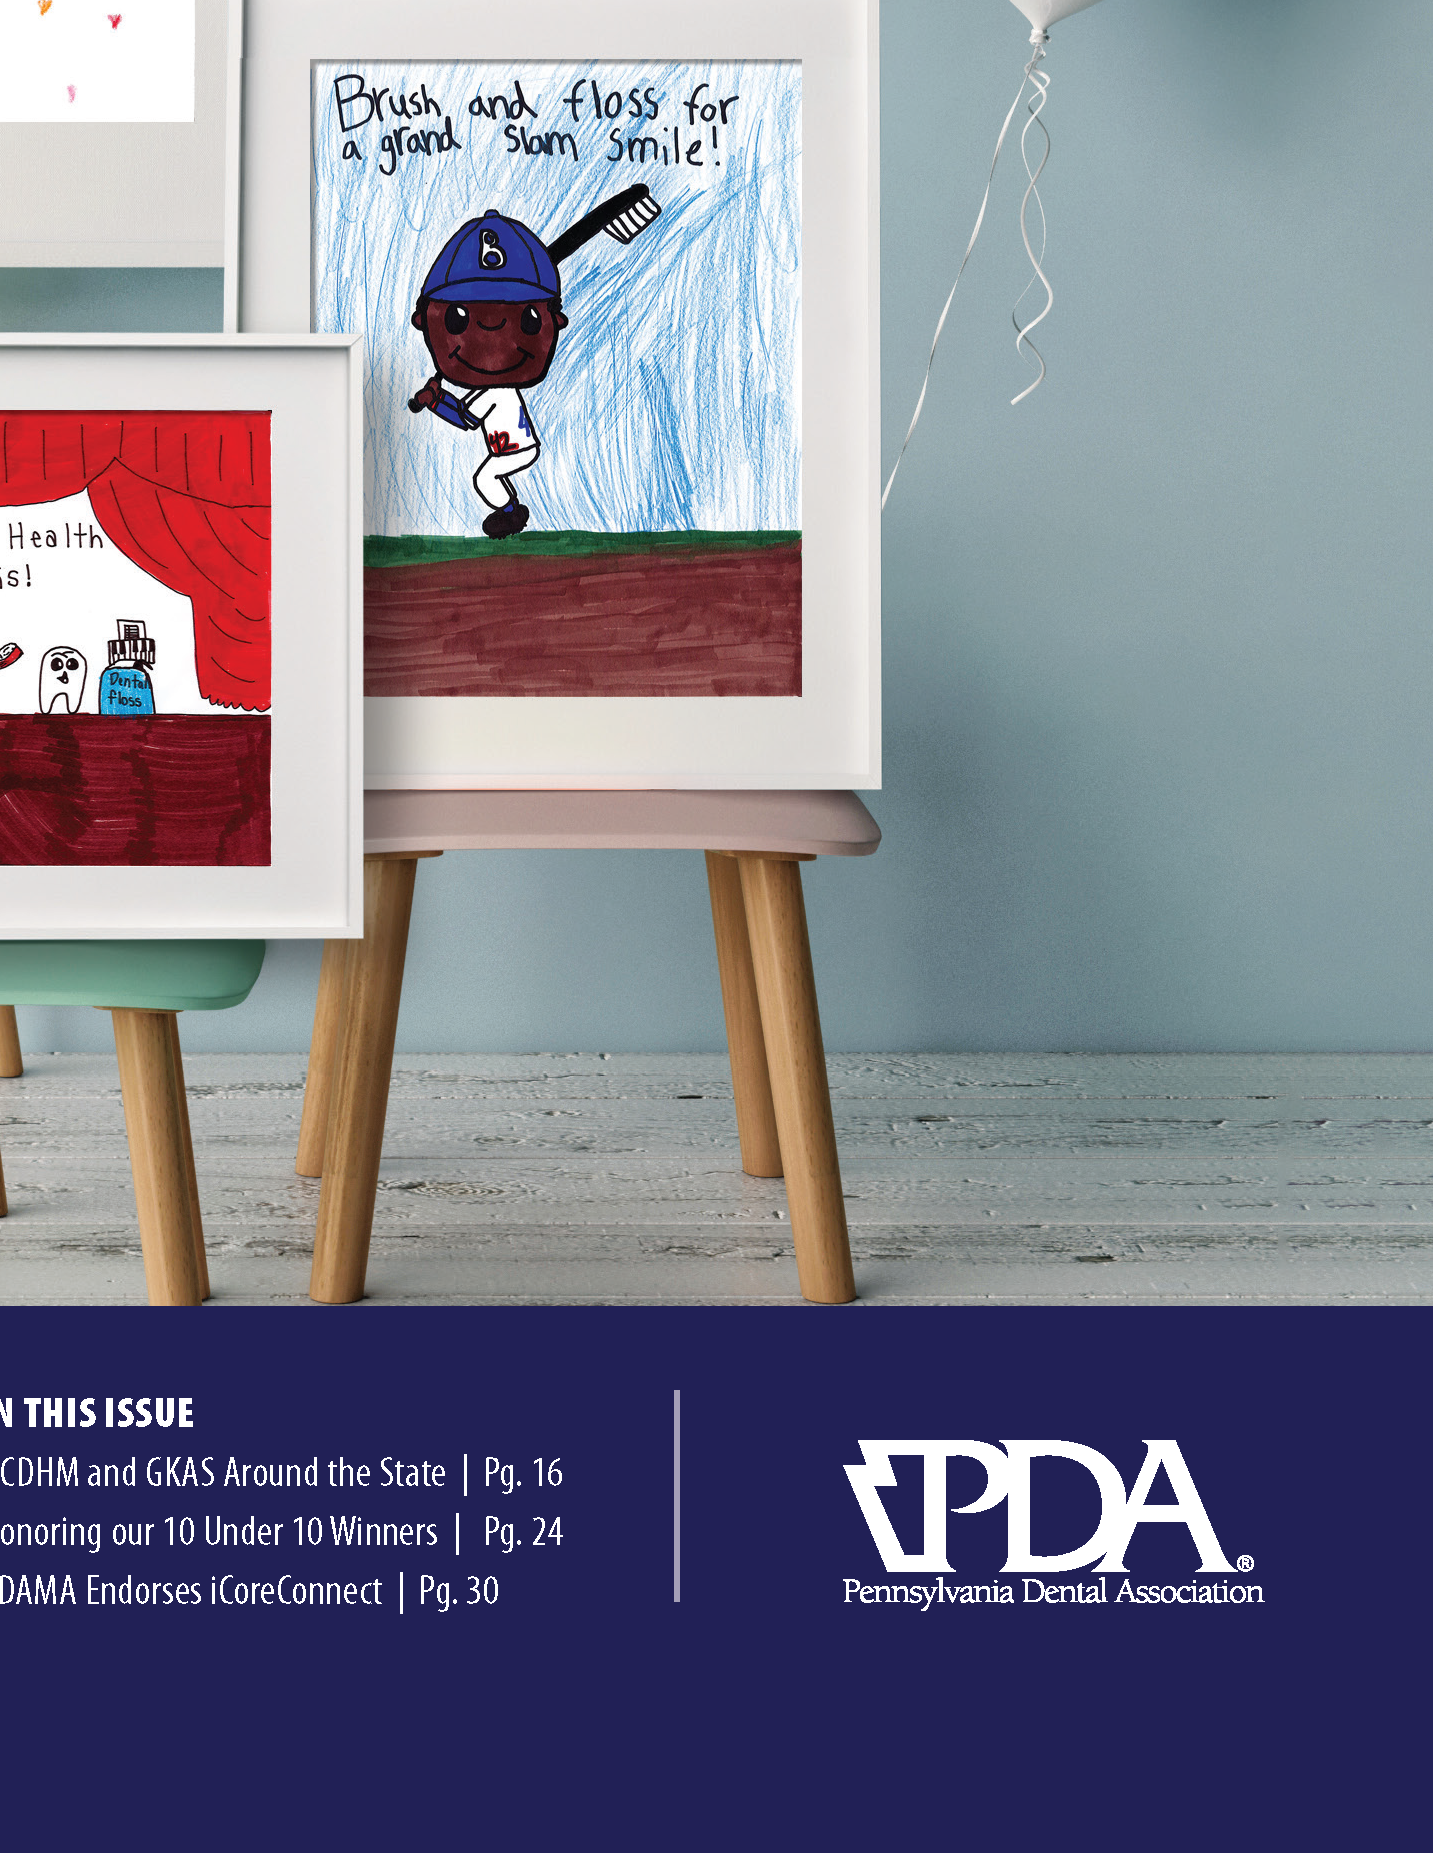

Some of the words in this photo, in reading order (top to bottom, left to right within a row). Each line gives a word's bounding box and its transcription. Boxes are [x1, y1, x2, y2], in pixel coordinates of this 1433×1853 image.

[469, 80, 538, 120] and
[563, 79, 658, 122] floss
[684, 83, 739, 125] for
[342, 140, 362, 160] a
[379, 116, 462, 176] grand
[9, 522, 103, 549] Health
